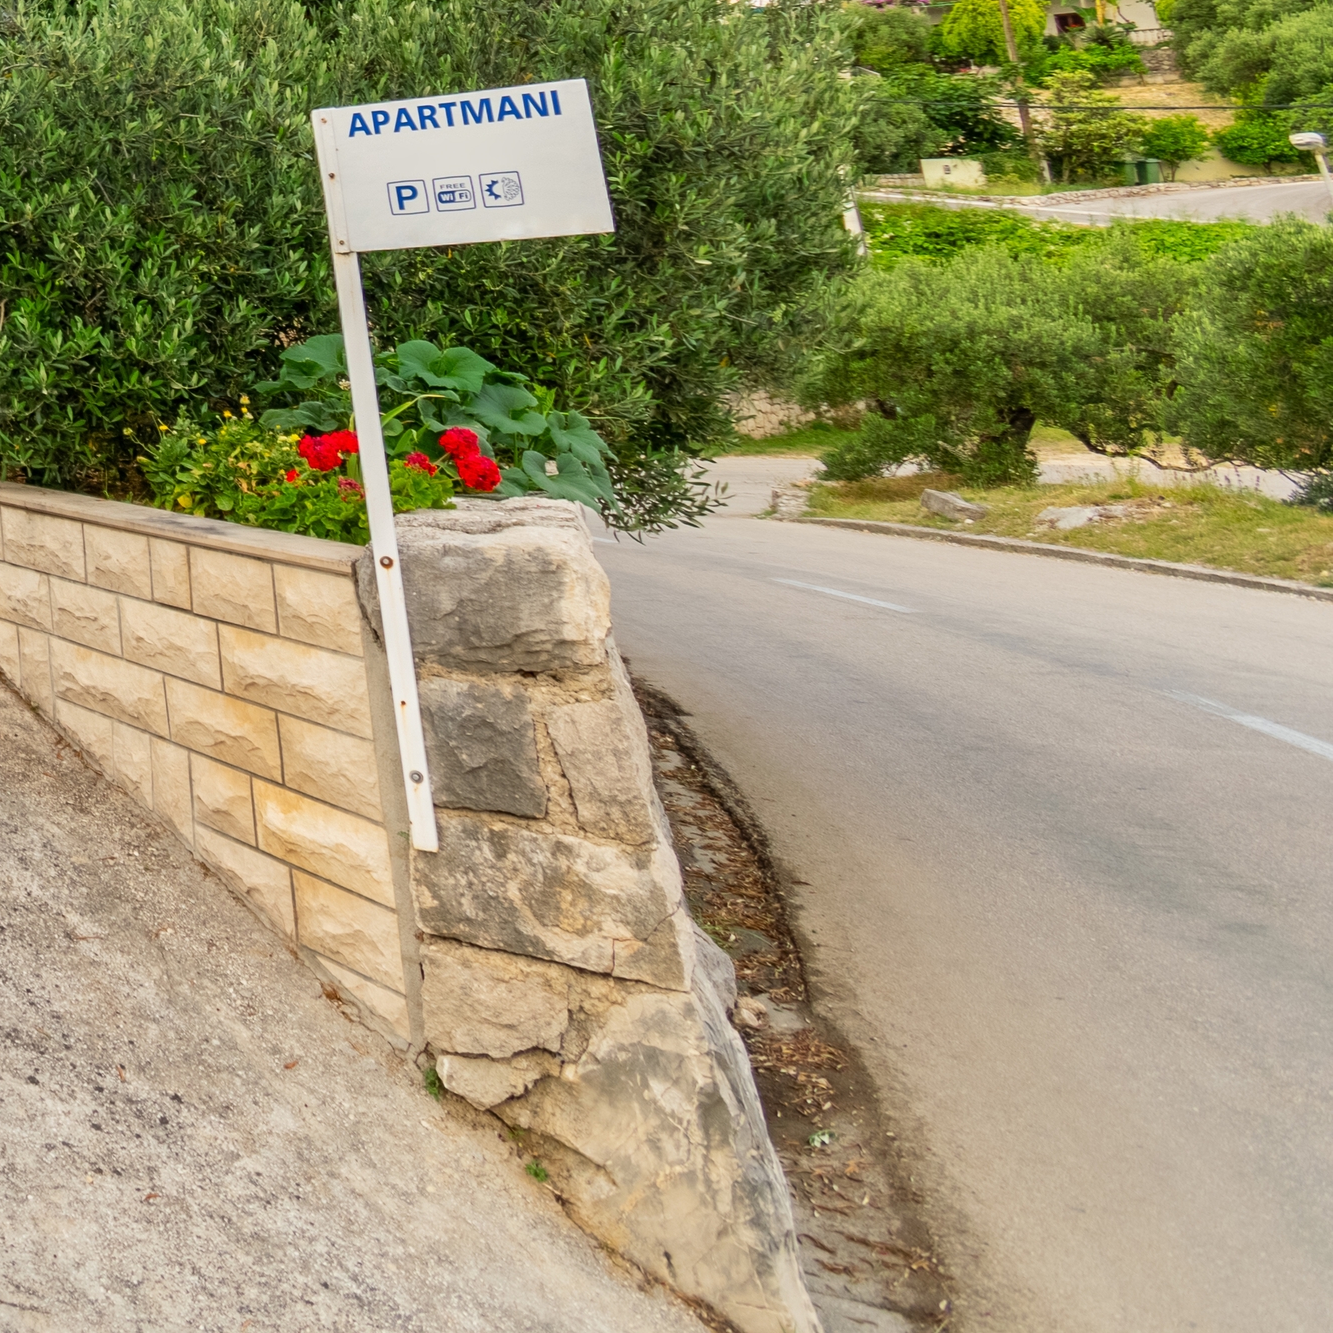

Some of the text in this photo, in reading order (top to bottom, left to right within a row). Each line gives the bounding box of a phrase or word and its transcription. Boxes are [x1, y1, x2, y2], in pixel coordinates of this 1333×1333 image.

[348, 89, 563, 138] APARTMANI
[395, 185, 419, 211] P
[439, 182, 466, 190] FREE
